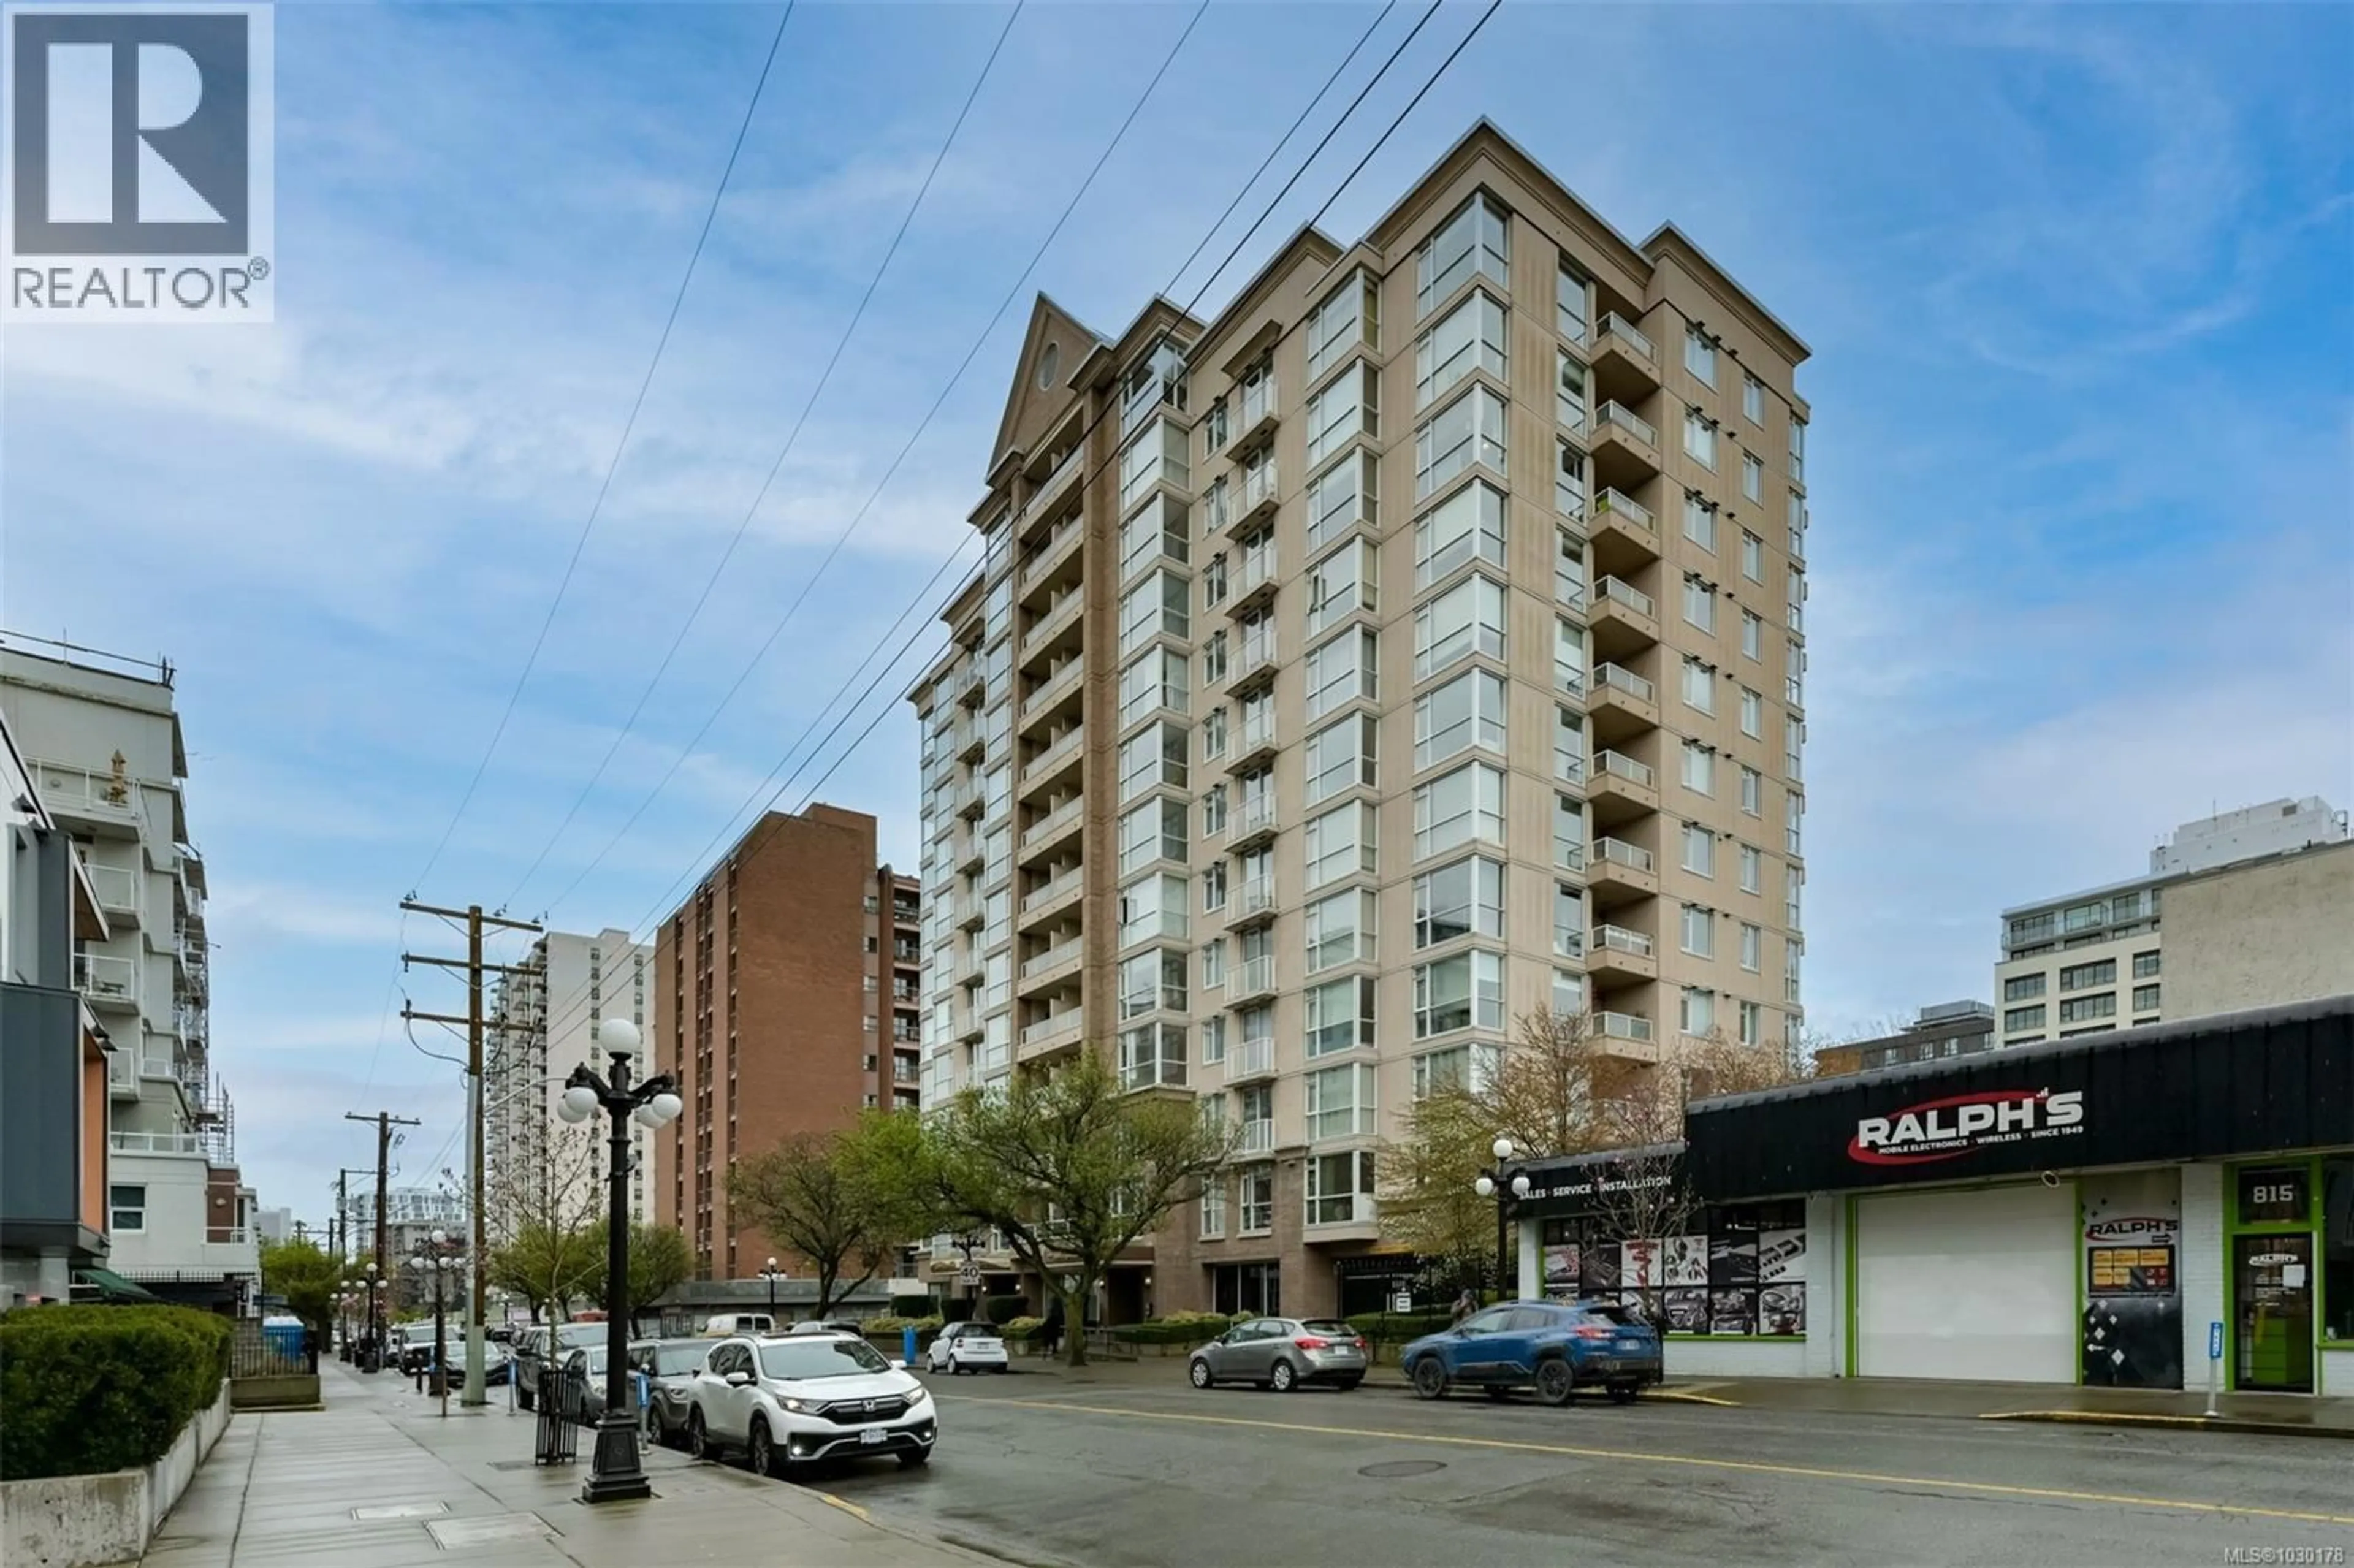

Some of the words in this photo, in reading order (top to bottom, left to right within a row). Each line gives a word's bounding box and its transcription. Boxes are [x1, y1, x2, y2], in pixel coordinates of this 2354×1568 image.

[1858, 1087, 2084, 1148] RALPH'S
[1910, 1138, 1968, 1152] ELECTRONICS
[1976, 1133, 2022, 1144] WIRELESS
[2031, 1127, 2059, 1138] SINCE
[1553, 1183, 1592, 1198] SERVICE
[2253, 1184, 2295, 1203] 815
[960, 1266, 978, 1278] 40
